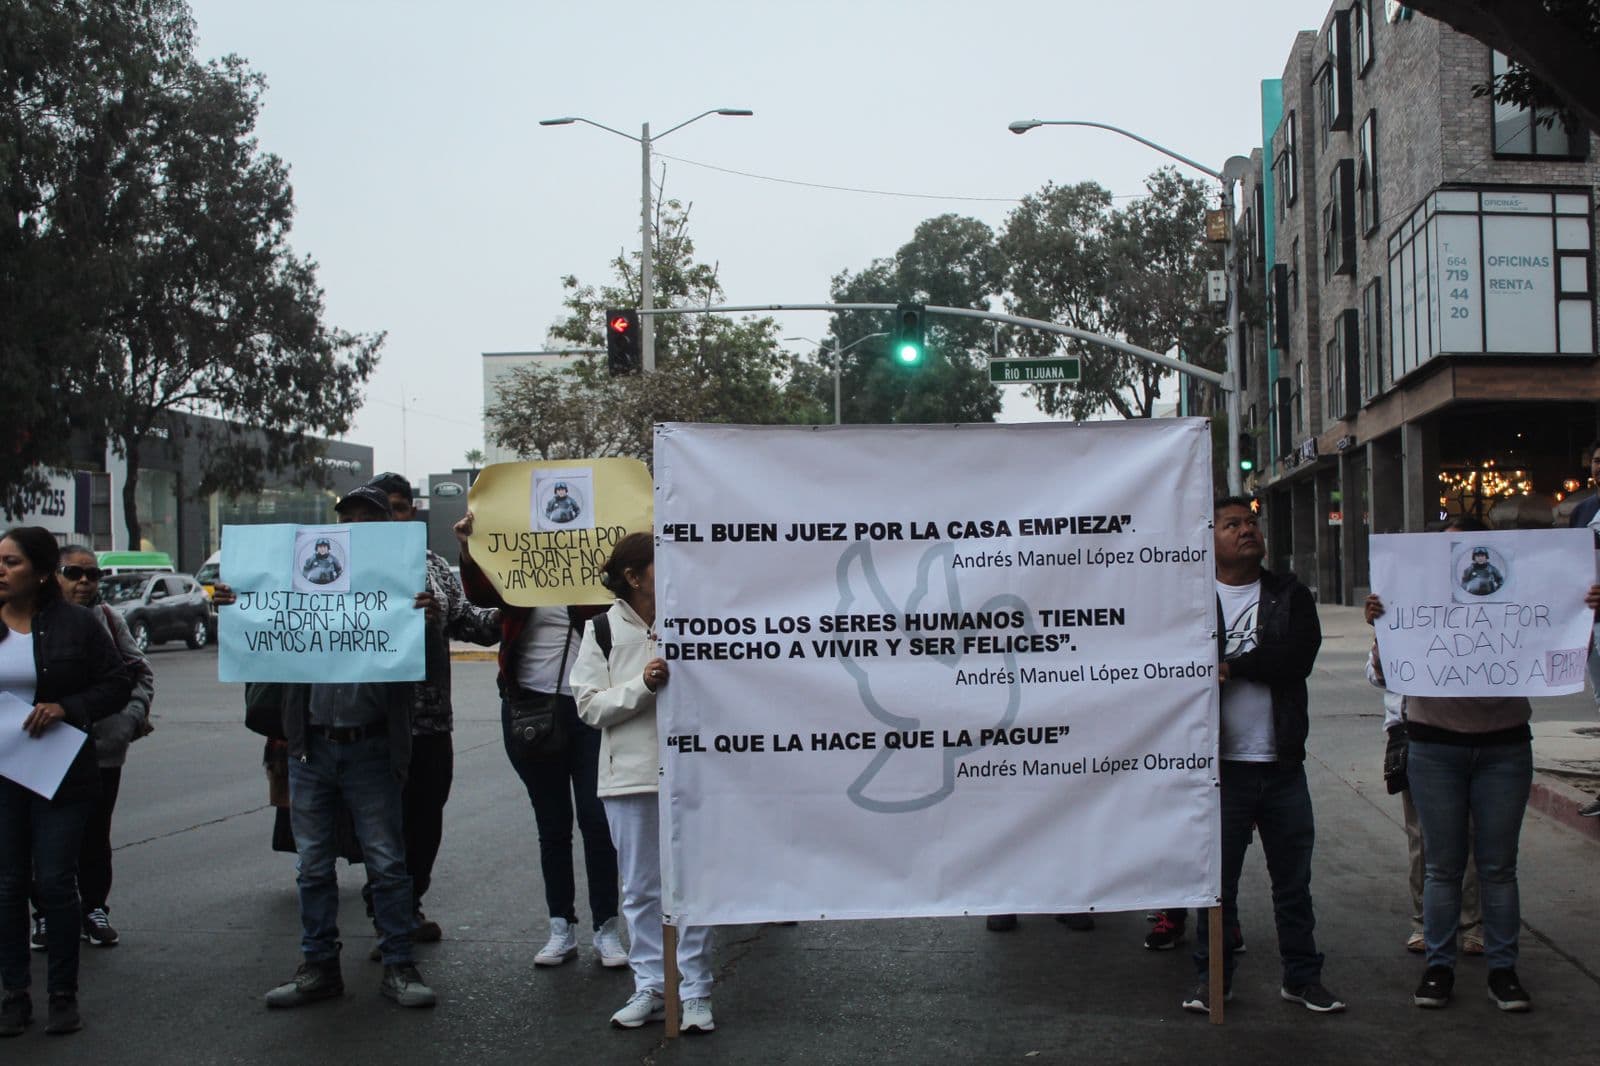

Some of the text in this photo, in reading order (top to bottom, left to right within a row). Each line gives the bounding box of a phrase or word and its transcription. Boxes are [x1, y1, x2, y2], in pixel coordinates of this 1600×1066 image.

[1447, 257, 1467, 266] 664
[1487, 255, 1550, 268] OFICINAS
[1446, 269, 1469, 282] 719
[1489, 279, 1534, 290] RENTA
[1450, 288, 1469, 300] 44
[1450, 306, 1469, 319] 20
[1004, 366, 1065, 380] RIO TIJUANA
[488, 528, 591, 553] JUSTICIA
[712, 524, 777, 542] BUEN
[785, 523, 847, 541] JUEZ
[855, 522, 903, 541] POR
[911, 522, 940, 539] LA
[947, 520, 1012, 539] CASA
[952, 546, 1207, 568] Andrés Manuel López Obrador
[240, 590, 388, 612] JUSTICIA POR
[342, 611, 370, 631] NO
[765, 616, 811, 634] LOS
[819, 614, 897, 633] SERES
[905, 611, 1024, 631] HUMANOS
[1039, 608, 1124, 627] TIENEN
[1389, 604, 1551, 631] JUSTICIA POR
[244, 631, 306, 653] VAMOS
[310, 631, 323, 652] A
[664, 641, 780, 660] DERECHO
[789, 641, 805, 658] A
[812, 639, 878, 658] VIVIR
[886, 639, 902, 656] Y
[910, 638, 956, 655] SER
[956, 661, 1214, 685] Andrés Manuel López Obrador
[1390, 659, 1416, 682] NO
[1427, 660, 1520, 687] VAMOS
[1526, 659, 1548, 683] A
[714, 735, 764, 753] QUE
[774, 734, 803, 752] LA
[812, 732, 876, 751] HACE
[885, 731, 934, 750] QUE
[943, 730, 973, 747] LA
[957, 753, 1214, 777] Andrés Manuel López Obrador
